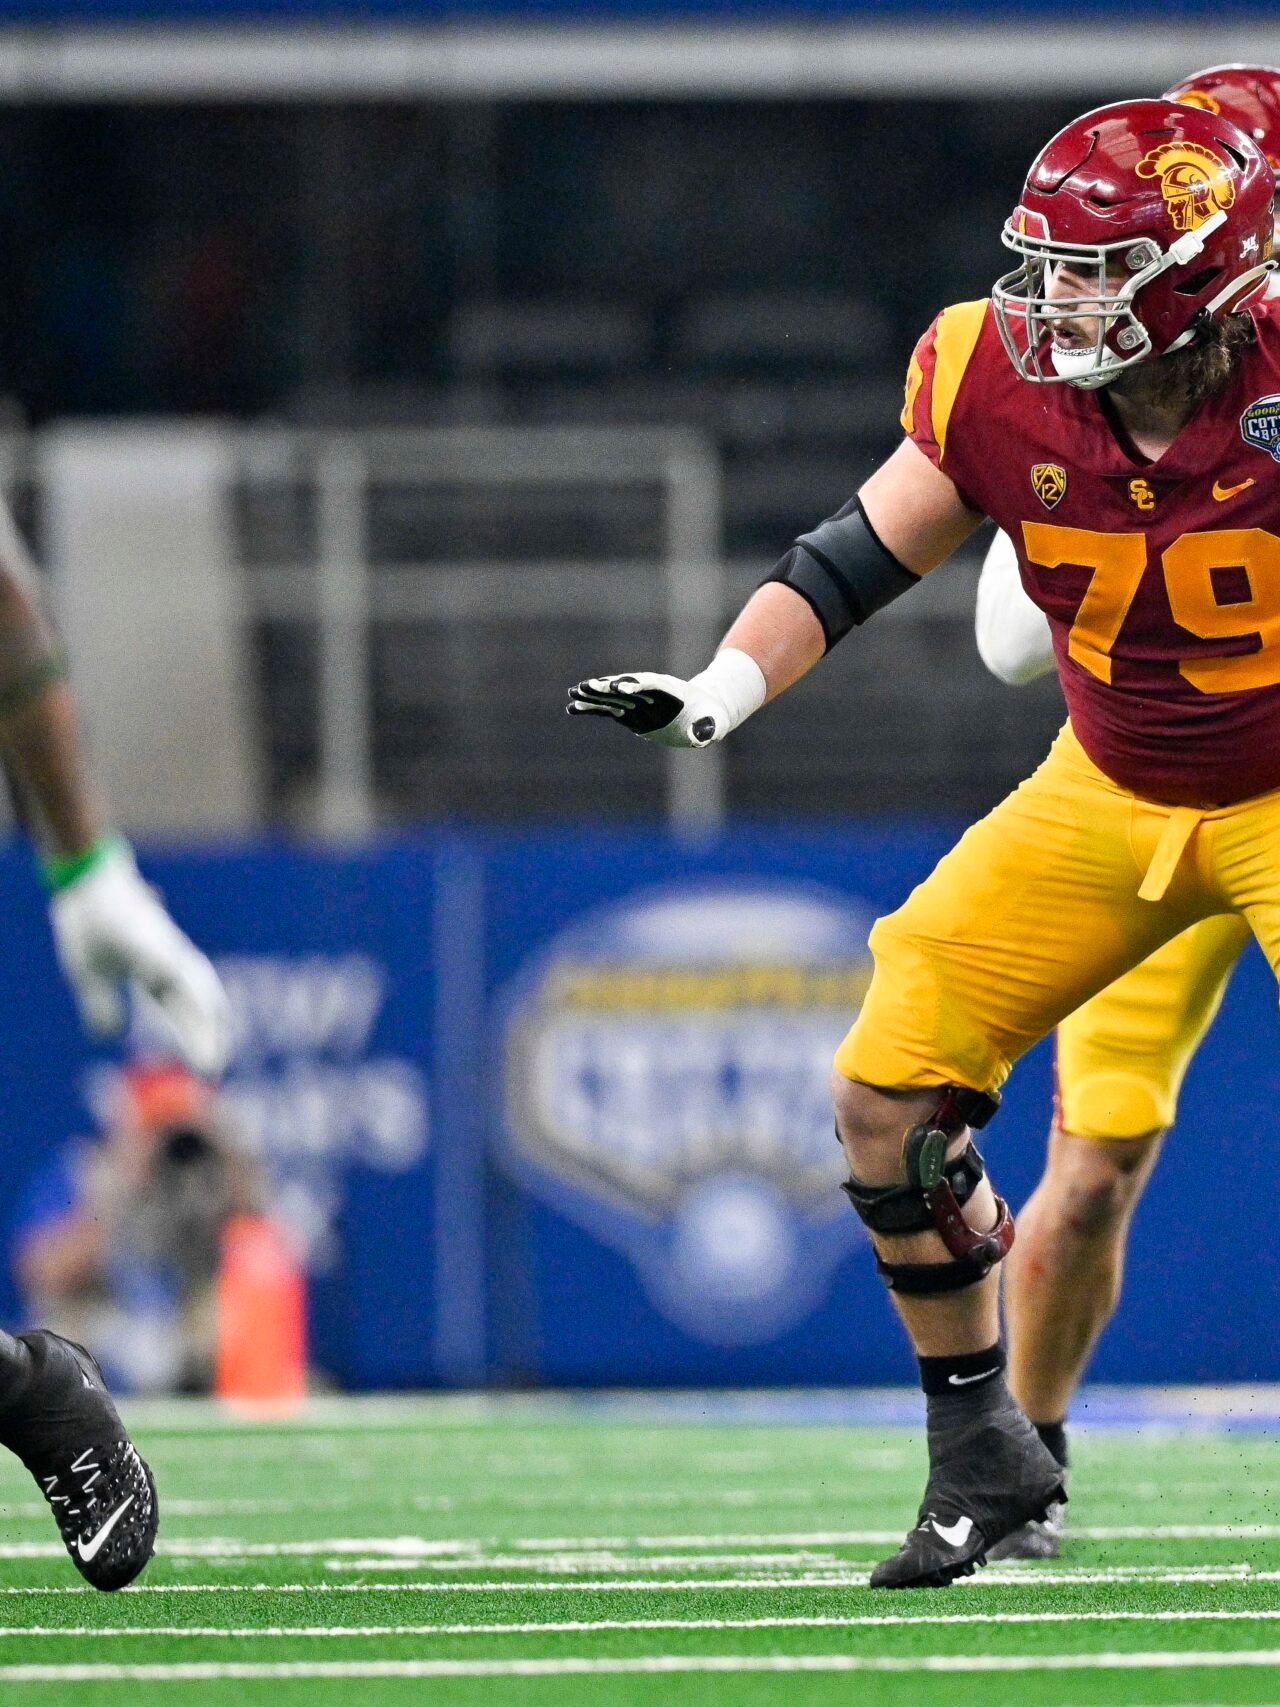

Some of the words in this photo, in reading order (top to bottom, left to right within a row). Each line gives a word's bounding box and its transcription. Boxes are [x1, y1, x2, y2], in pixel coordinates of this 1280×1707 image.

[1033, 465, 1064, 493] PAC
[1041, 483, 1058, 500] 12
[1129, 479, 1155, 510] SC
